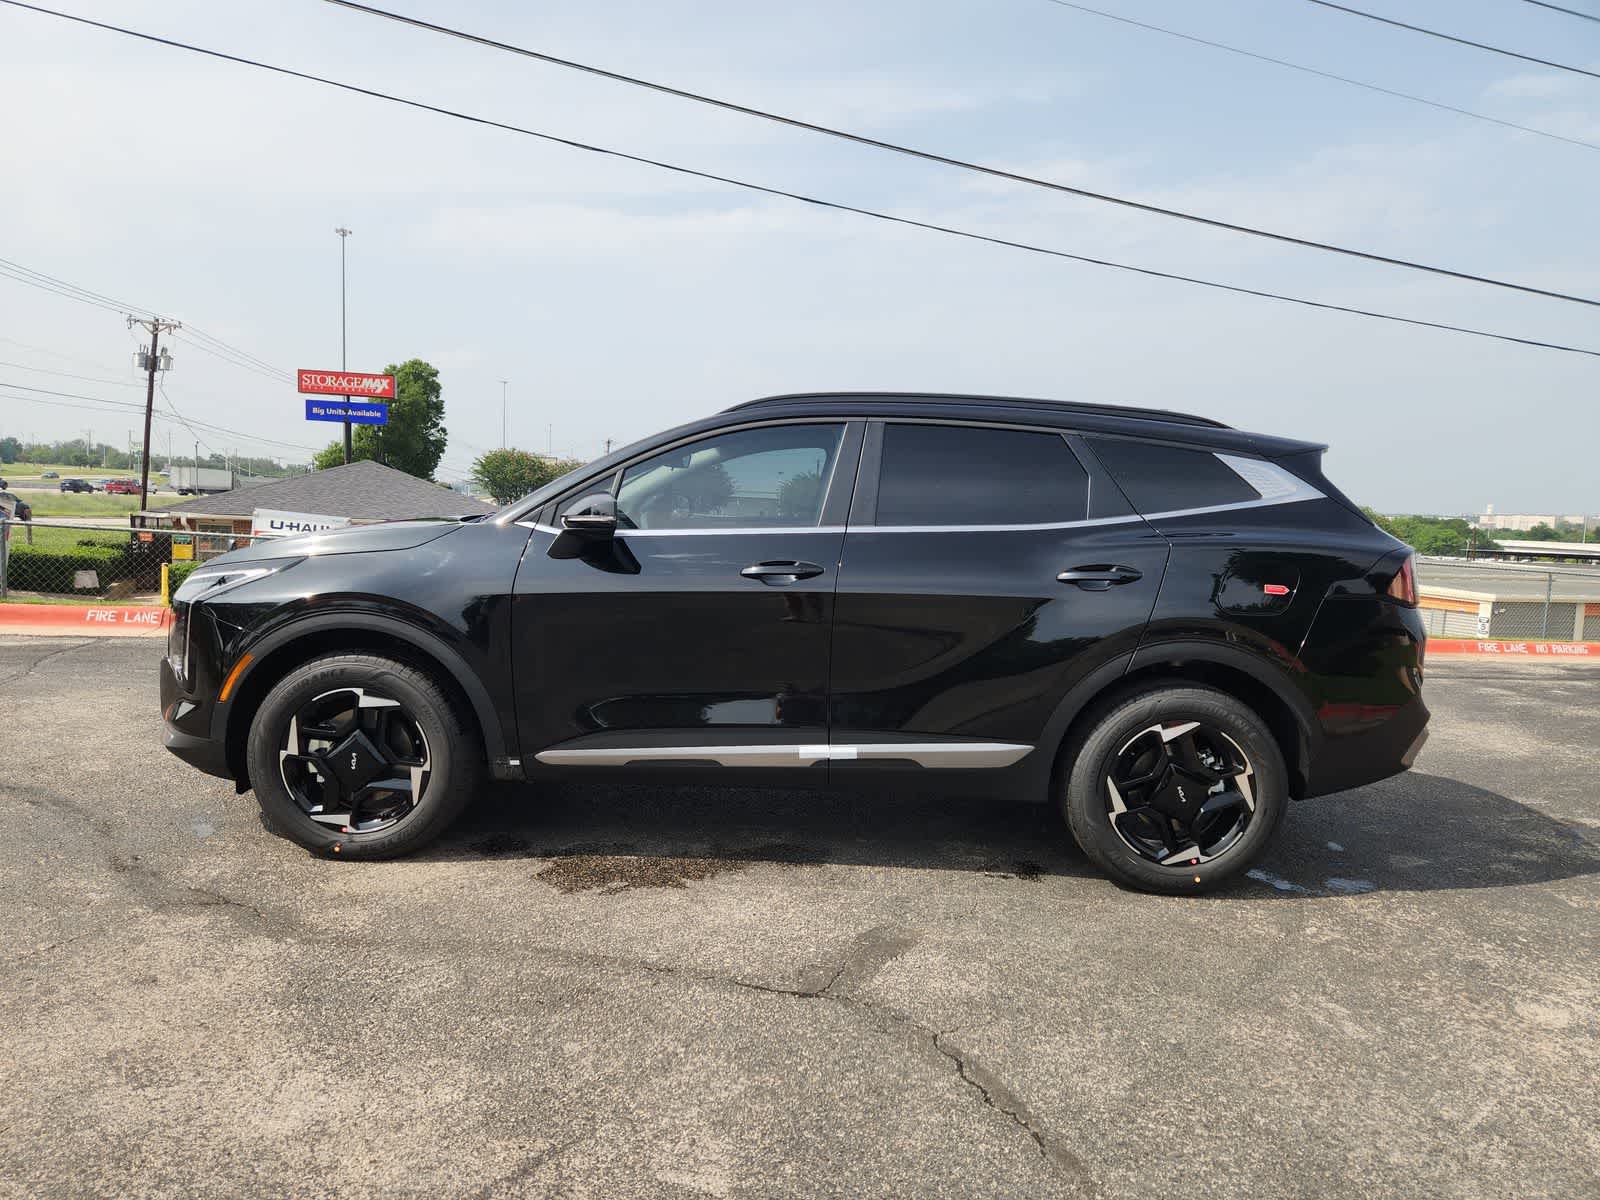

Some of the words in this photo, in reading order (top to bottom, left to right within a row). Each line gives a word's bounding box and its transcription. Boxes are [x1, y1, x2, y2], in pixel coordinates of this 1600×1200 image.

[312, 407, 325, 416] Big
[326, 408, 346, 416] Units
[347, 409, 381, 418] Available
[86, 609, 118, 622] FIRE
[124, 611, 160, 624] LANE
[1478, 642, 1500, 653] FIRE
[1503, 643, 1528, 654] LANE
[1551, 644, 1588, 655] PARKING
